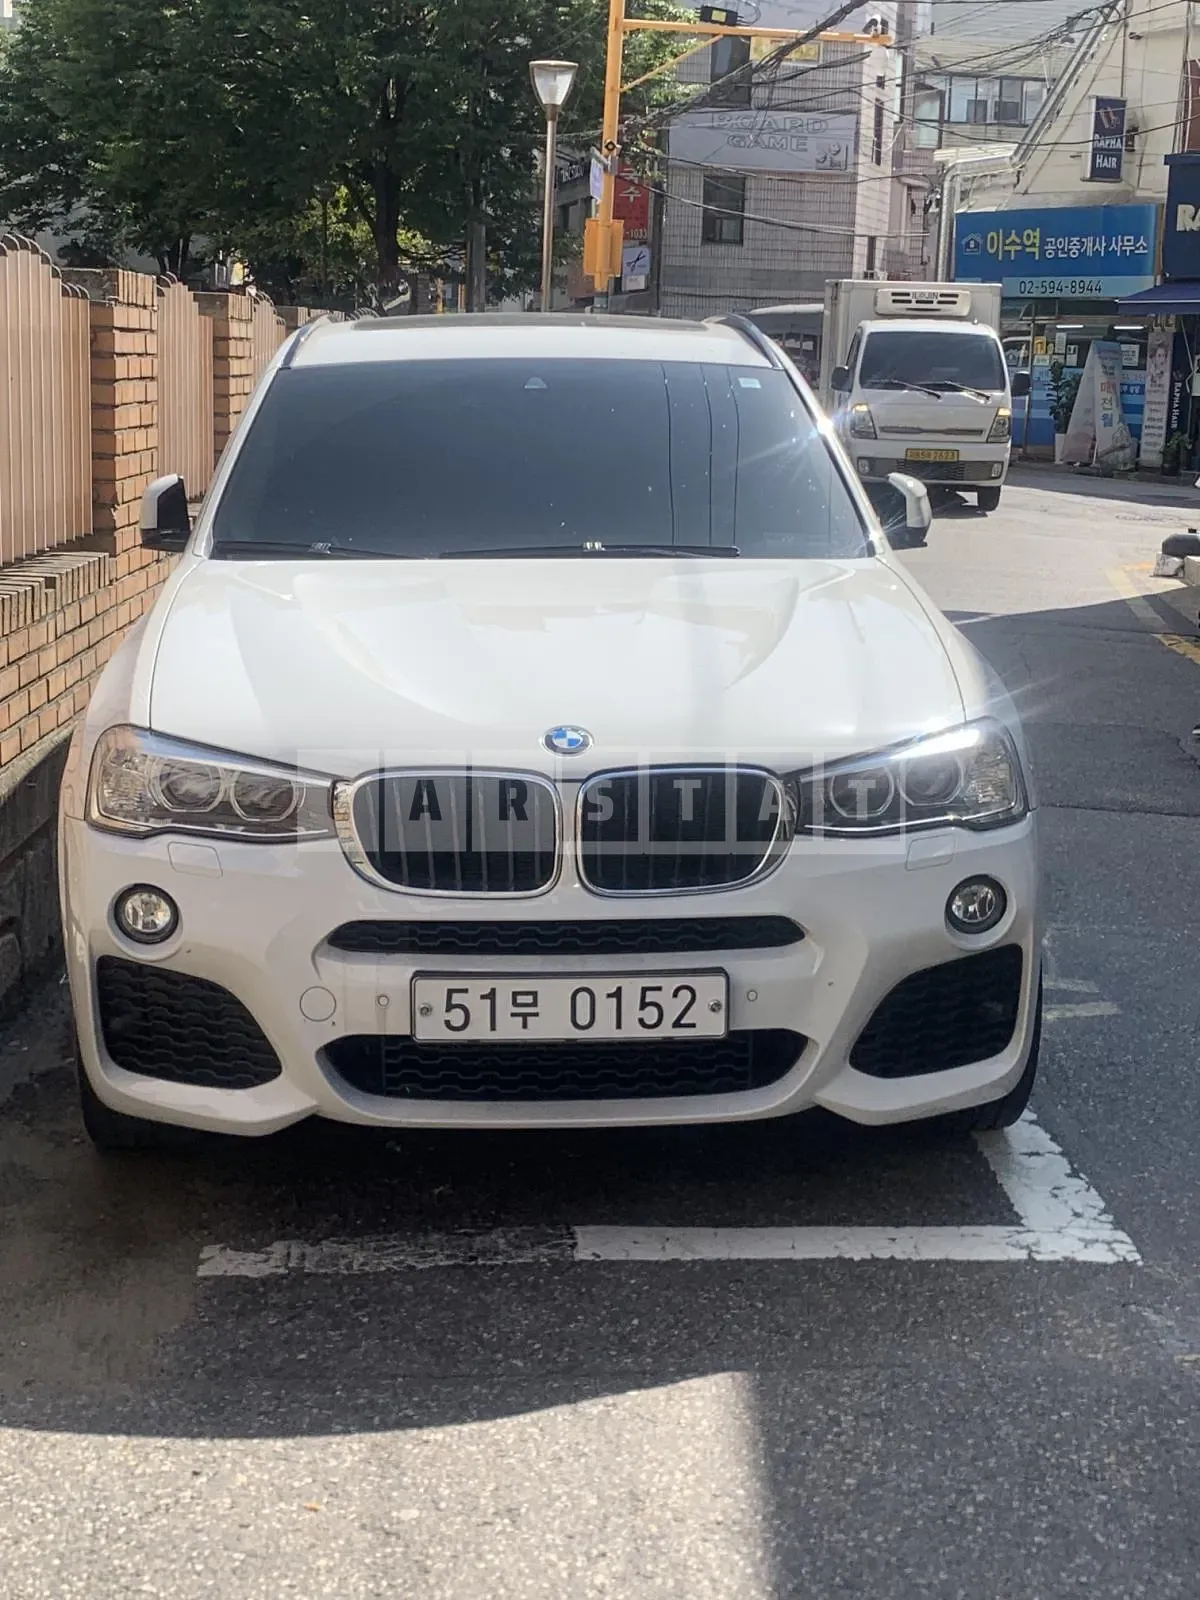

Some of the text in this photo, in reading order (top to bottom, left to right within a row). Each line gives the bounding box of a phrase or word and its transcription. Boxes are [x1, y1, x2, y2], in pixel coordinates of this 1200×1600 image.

[712, 113, 830, 133] BOARD
[726, 135, 809, 152] GAME
[1094, 134, 1122, 149] RAPHA
[1095, 154, 1118, 169] HAIR
[986, 228, 1148, 261] 이수역 공인중개사 사무소
[1018, 280, 1102, 295] 02-594-8944
[443, 984, 698, 1032] 51무 0152
